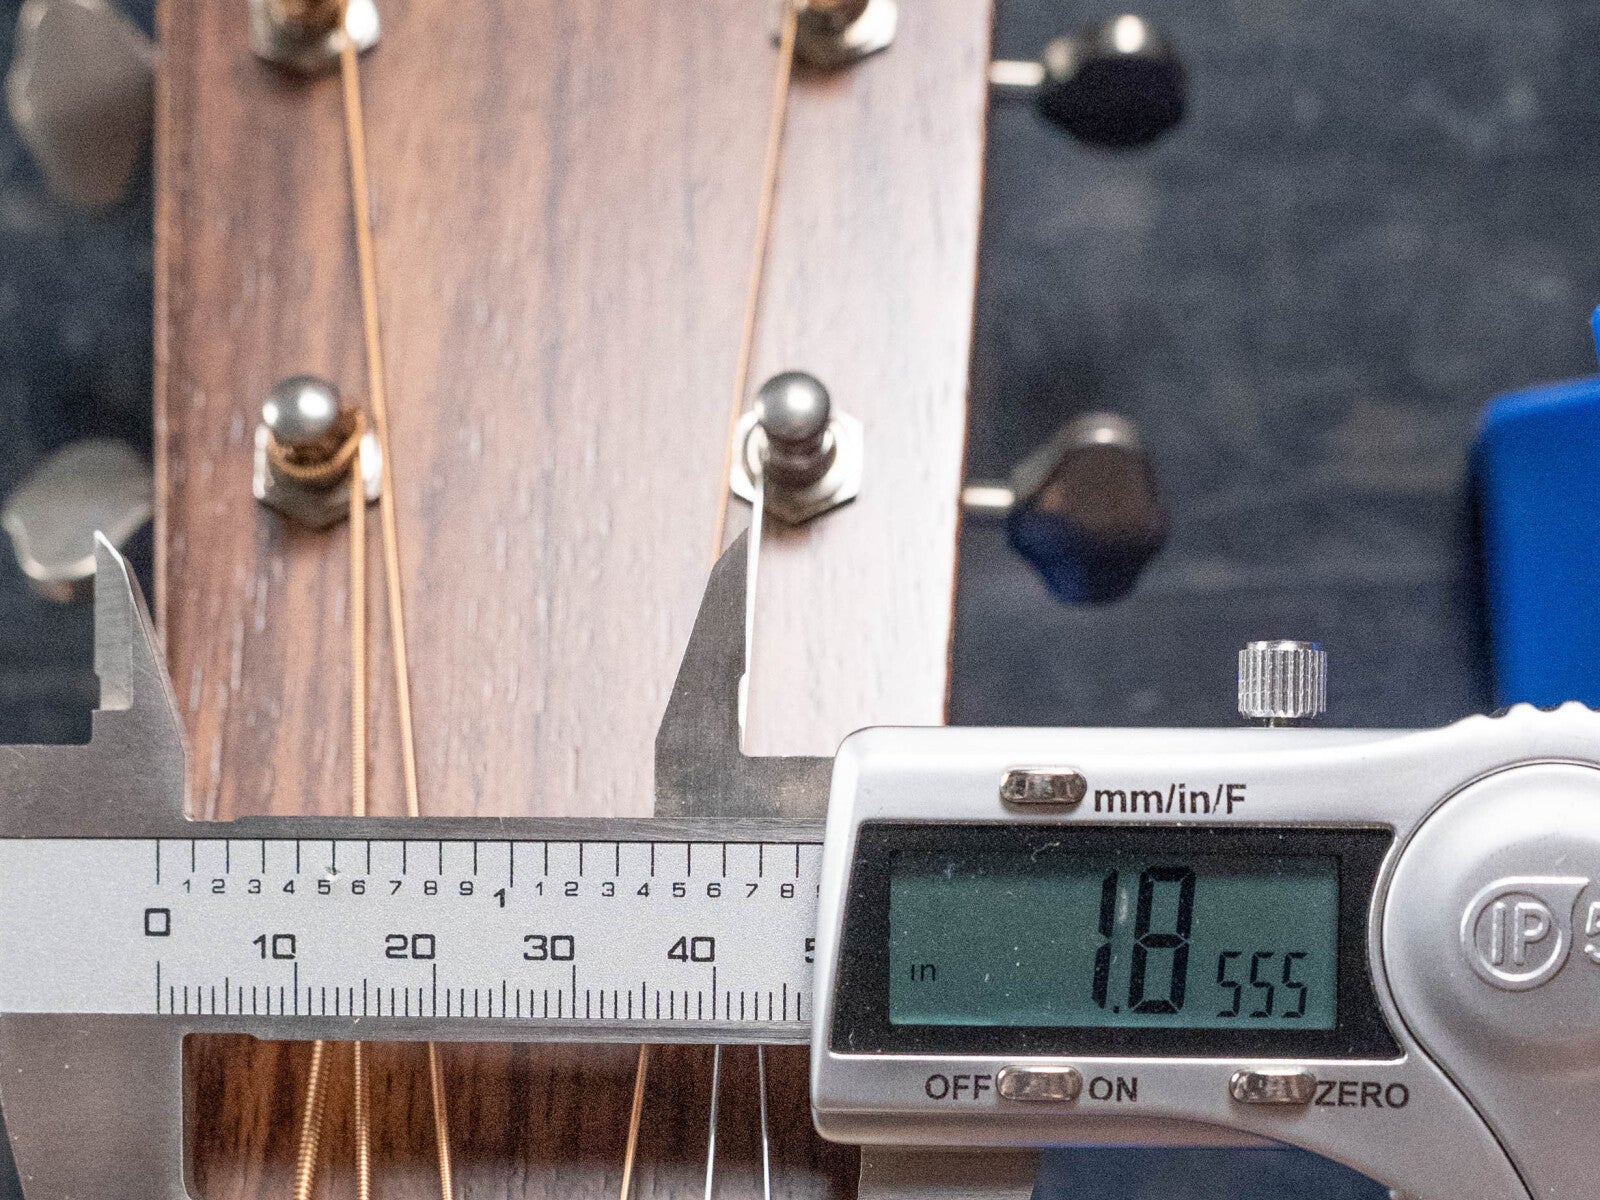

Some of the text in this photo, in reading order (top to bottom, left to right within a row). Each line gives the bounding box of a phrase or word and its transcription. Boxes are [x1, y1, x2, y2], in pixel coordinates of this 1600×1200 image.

[1094, 783, 1247, 815] mm/in/F
[182, 879, 794, 908] 1 2 3 4 5 6 7 8 9 1 1 2 3 4 5 6 7 8
[253, 934, 296, 959] 10
[385, 934, 435, 959] 20
[524, 935, 574, 961] 30
[668, 936, 715, 962] 40
[909, 962, 937, 981] in
[924, 1073, 992, 1101] OFF
[1088, 1076, 1138, 1101] ON
[1313, 1080, 1409, 1108] ZERO
